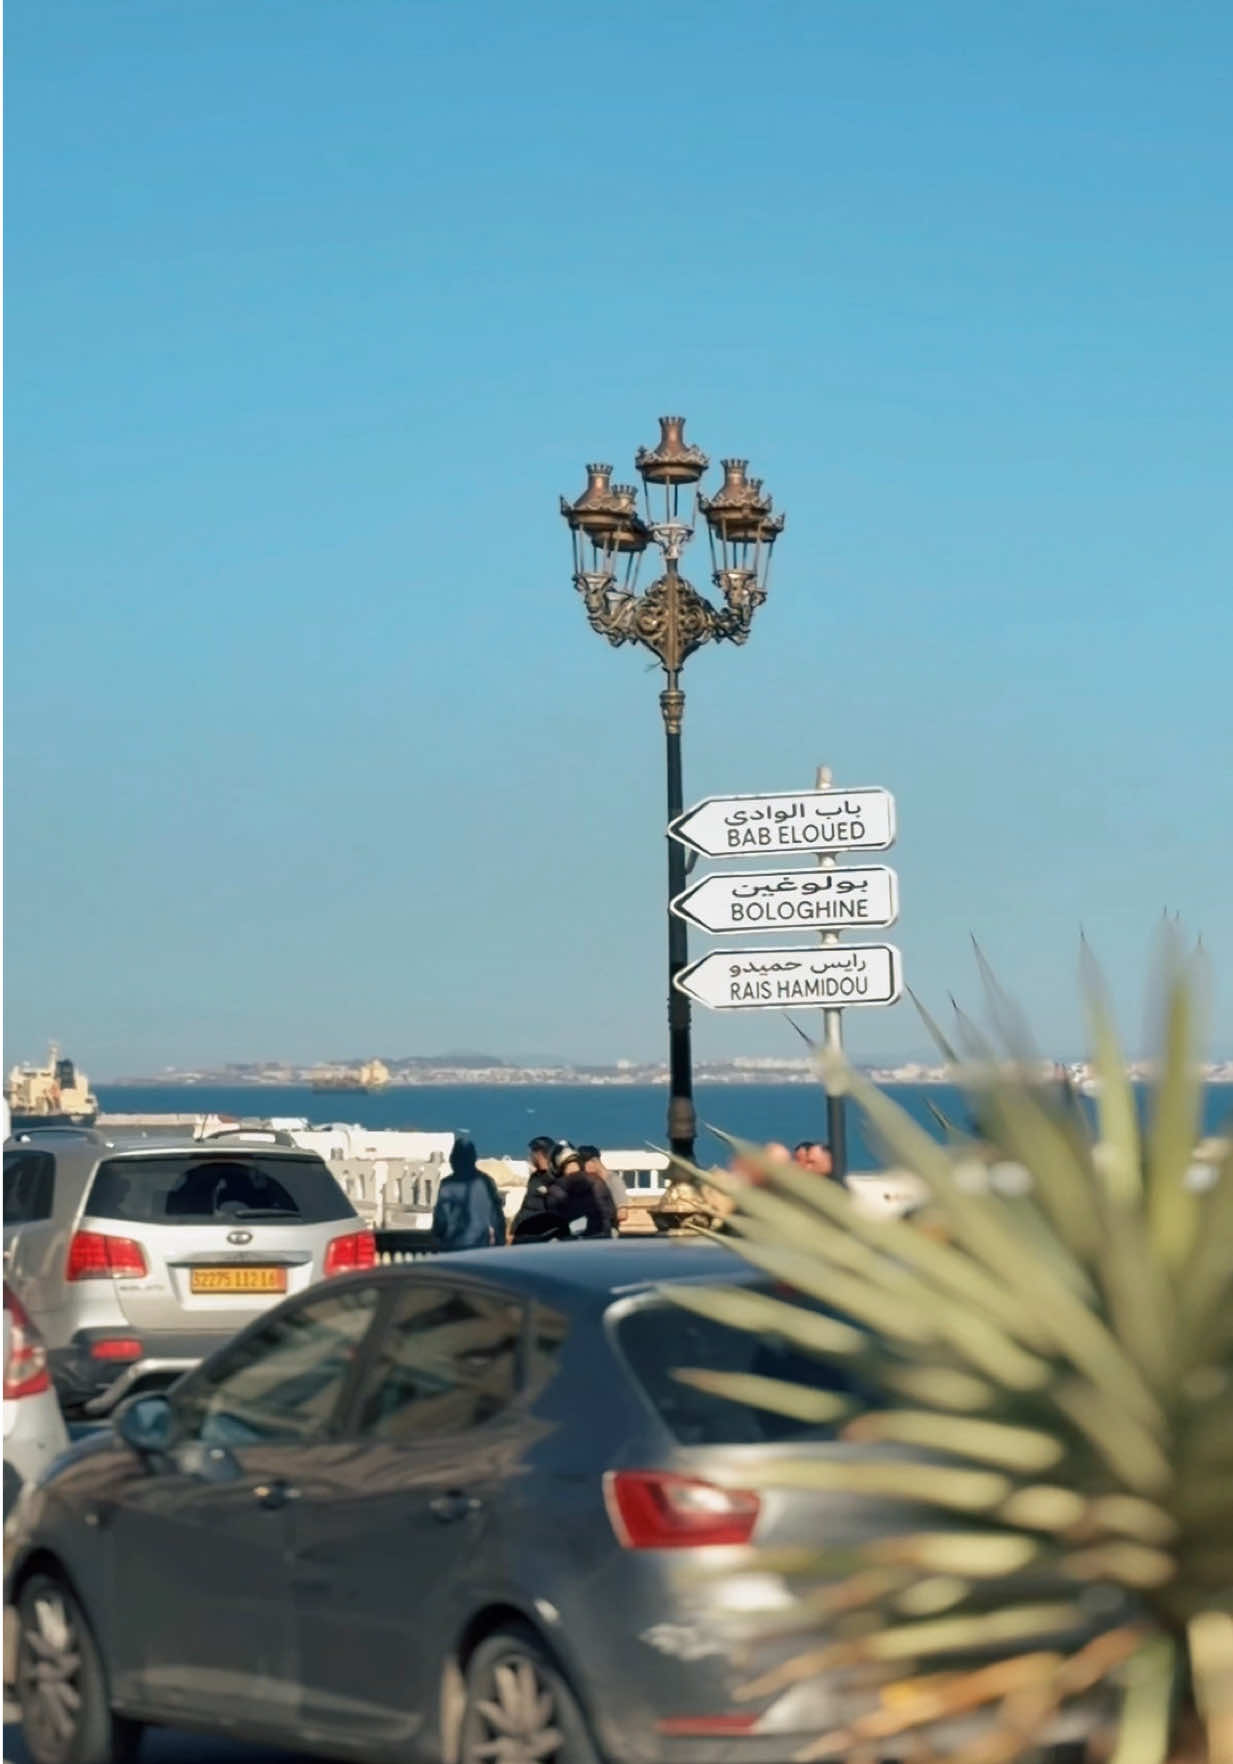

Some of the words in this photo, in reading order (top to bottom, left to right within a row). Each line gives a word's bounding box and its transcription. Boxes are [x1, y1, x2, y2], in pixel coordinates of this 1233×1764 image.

[815, 800, 861, 820] باب
[727, 827, 772, 847] BAB
[778, 821, 866, 844] ELOUED
[732, 875, 868, 898] بولوغين
[731, 899, 869, 921] BOLOGHINE
[729, 961, 802, 977] حميدو
[810, 953, 866, 974] رايس
[730, 980, 772, 1000] RAIS
[777, 977, 868, 998] HAMIDOU
